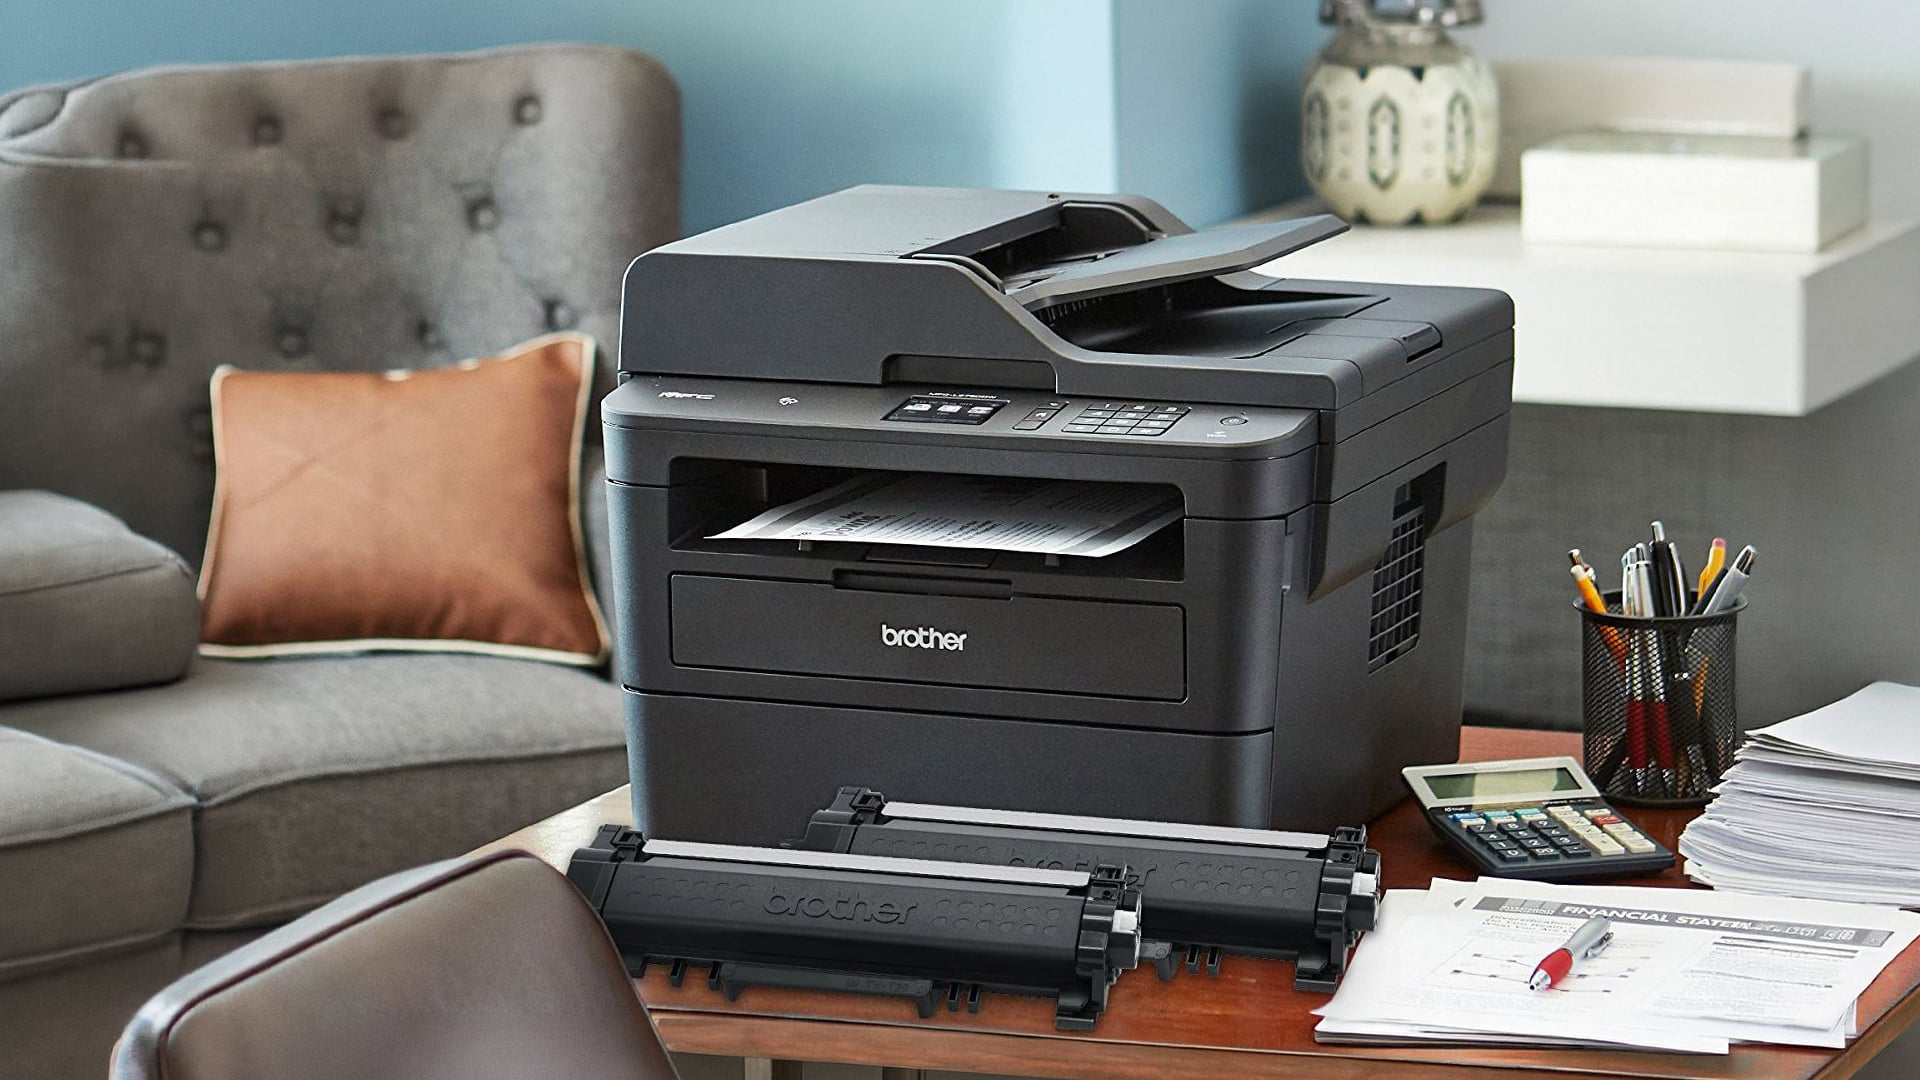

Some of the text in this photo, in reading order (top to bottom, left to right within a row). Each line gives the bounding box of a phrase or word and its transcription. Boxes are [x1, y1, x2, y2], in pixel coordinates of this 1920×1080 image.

[881, 624, 968, 651] brother
[763, 885, 919, 924] brother
[1562, 906, 1670, 923] FINANCIAL
